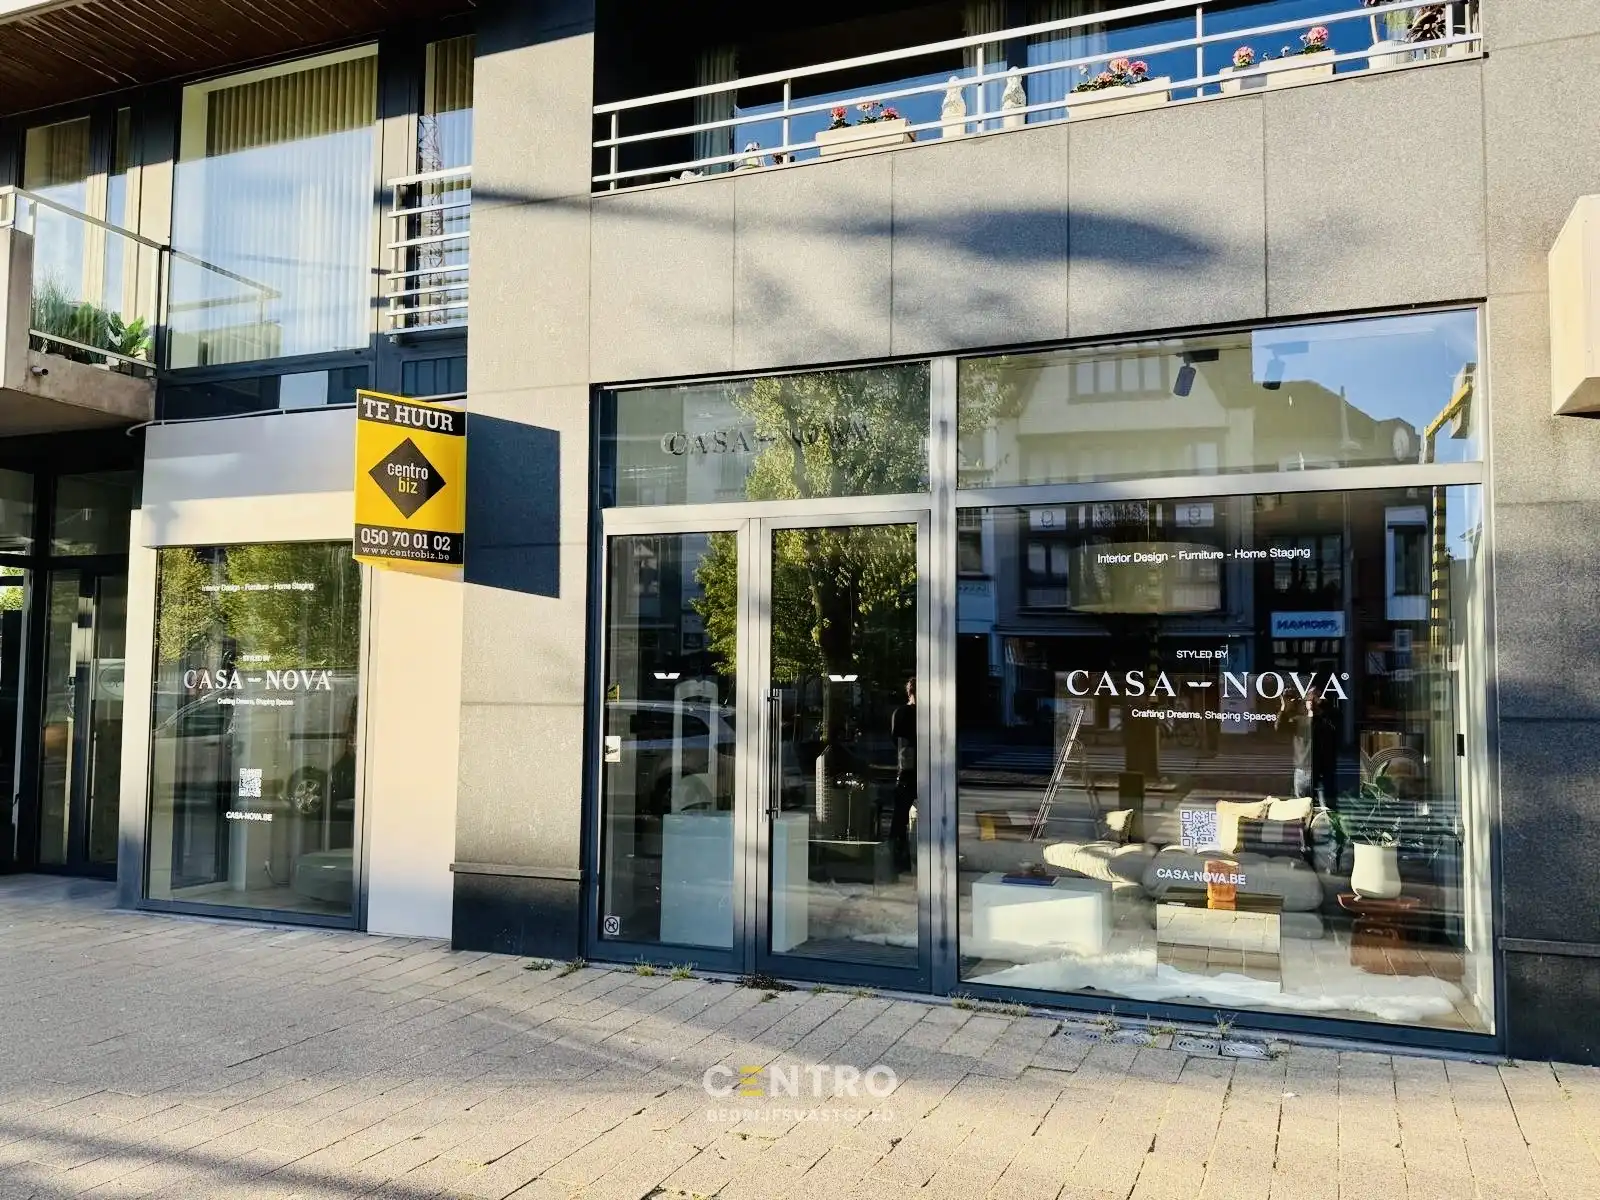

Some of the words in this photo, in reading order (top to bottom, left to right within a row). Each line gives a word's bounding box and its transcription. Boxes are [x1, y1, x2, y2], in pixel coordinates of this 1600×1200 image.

[363, 398, 389, 420] TE
[394, 404, 453, 432] HUUR
[660, 430, 750, 456] CASA
[387, 462, 429, 480] centro
[398, 476, 418, 494] biz
[361, 528, 388, 545] 050
[392, 531, 410, 547] 70
[413, 533, 429, 549] 01
[433, 535, 451, 551] 02
[362, 546, 450, 561] www.centrobiz.be
[1097, 553, 1131, 564] Interior
[1134, 552, 1169, 565] Design
[1178, 550, 1224, 561] Furniture
[1234, 549, 1267, 559] Home
[1270, 547, 1311, 559] Staging
[1176, 650, 1213, 659] STYLED
[1214, 650, 1228, 659] BY
[184, 669, 243, 690] CASA
[1066, 669, 1176, 697] CASA
[1131, 708, 1165, 720] Crafting
[1167, 709, 1203, 720] Dreams,
[1204, 710, 1240, 723] Shaping
[1243, 711, 1277, 722] Spaces
[226, 811, 273, 821] CASA-NOVA.BE
[1156, 868, 1246, 885] CASA-NOVA.BE
